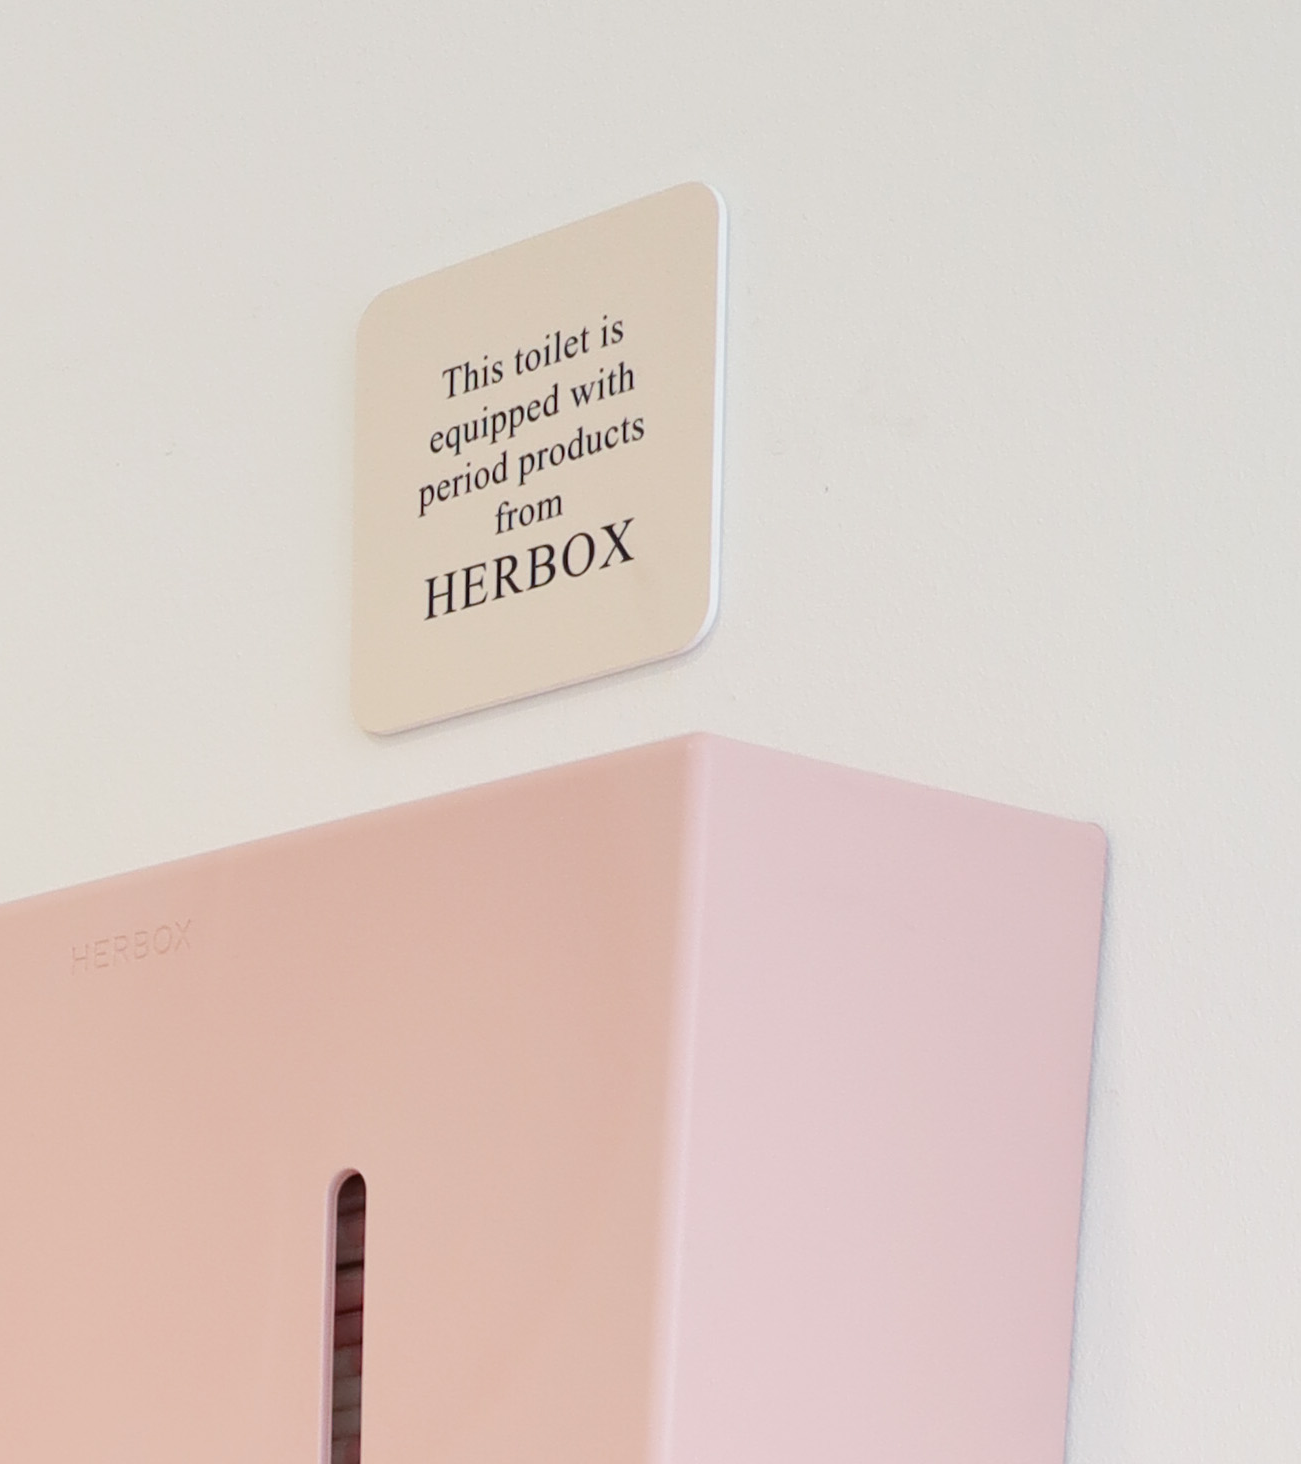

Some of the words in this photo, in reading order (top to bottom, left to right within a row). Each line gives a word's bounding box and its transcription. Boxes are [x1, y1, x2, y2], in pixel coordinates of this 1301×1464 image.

[442, 355, 504, 399] This
[515, 326, 590, 376] toilet
[600, 315, 624, 347] is
[429, 386, 560, 457] equipped
[571, 362, 636, 408] with
[418, 452, 508, 517] period
[518, 415, 645, 489] products
[495, 494, 564, 535] from
[423, 518, 636, 620] HERBOX
[71, 918, 192, 975] HERBOX
